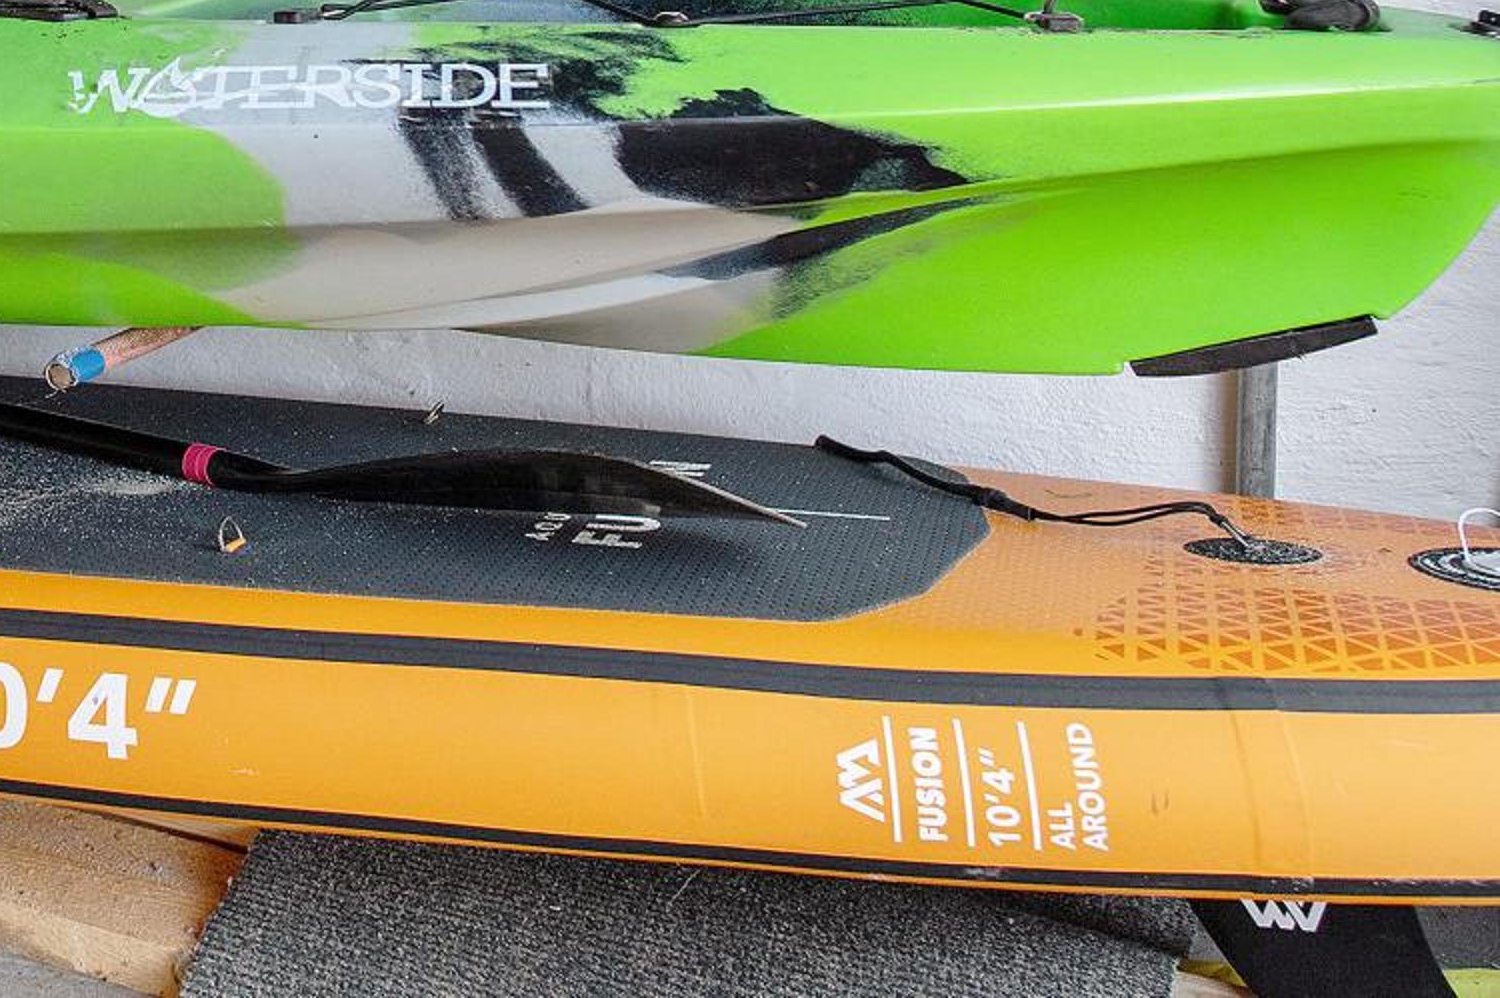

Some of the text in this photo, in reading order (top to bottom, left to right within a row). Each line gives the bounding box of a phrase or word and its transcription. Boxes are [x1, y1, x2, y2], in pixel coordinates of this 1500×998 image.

[67, 56, 551, 116] WATERSIDE
[524, 511, 572, 542] AQU
[907, 726, 949, 842] FUSION
[1065, 722, 1109, 851] AROUND
[1047, 802, 1077, 850] ALL
